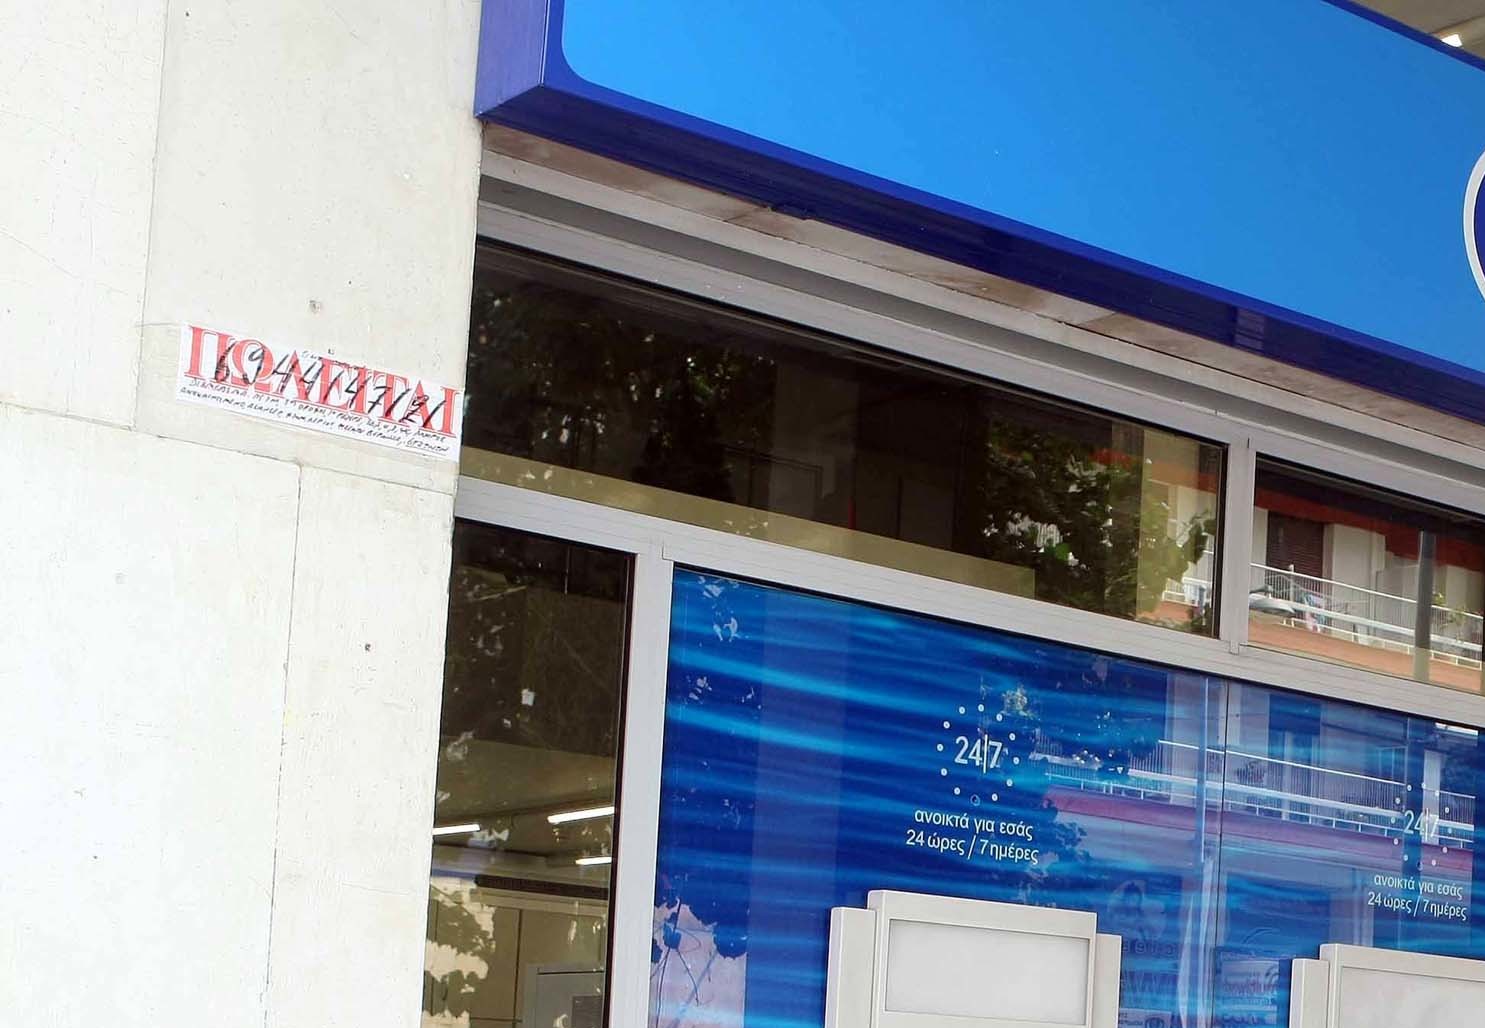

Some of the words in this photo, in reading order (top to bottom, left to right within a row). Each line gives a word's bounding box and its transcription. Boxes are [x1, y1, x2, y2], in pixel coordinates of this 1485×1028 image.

[184, 325, 461, 438] ΠΩΛΕΙΤΑΙ
[914, 808, 969, 829] ανοικτά
[974, 817, 995, 834] για
[999, 821, 1034, 841] εσάς
[906, 829, 925, 846] 24
[927, 832, 966, 855] ώρες
[967, 835, 977, 859] /
[980, 839, 989, 855] 7
[990, 841, 1039, 865] ημέρες
[1374, 874, 1415, 890] ανοικτά
[1418, 881, 1434, 895] για
[1437, 884, 1463, 900] εσάς
[1367, 892, 1382, 906] 24
[1383, 894, 1412, 913] ώρες
[1423, 899, 1430, 913] 7
[1430, 901, 1467, 921] ημέρες
